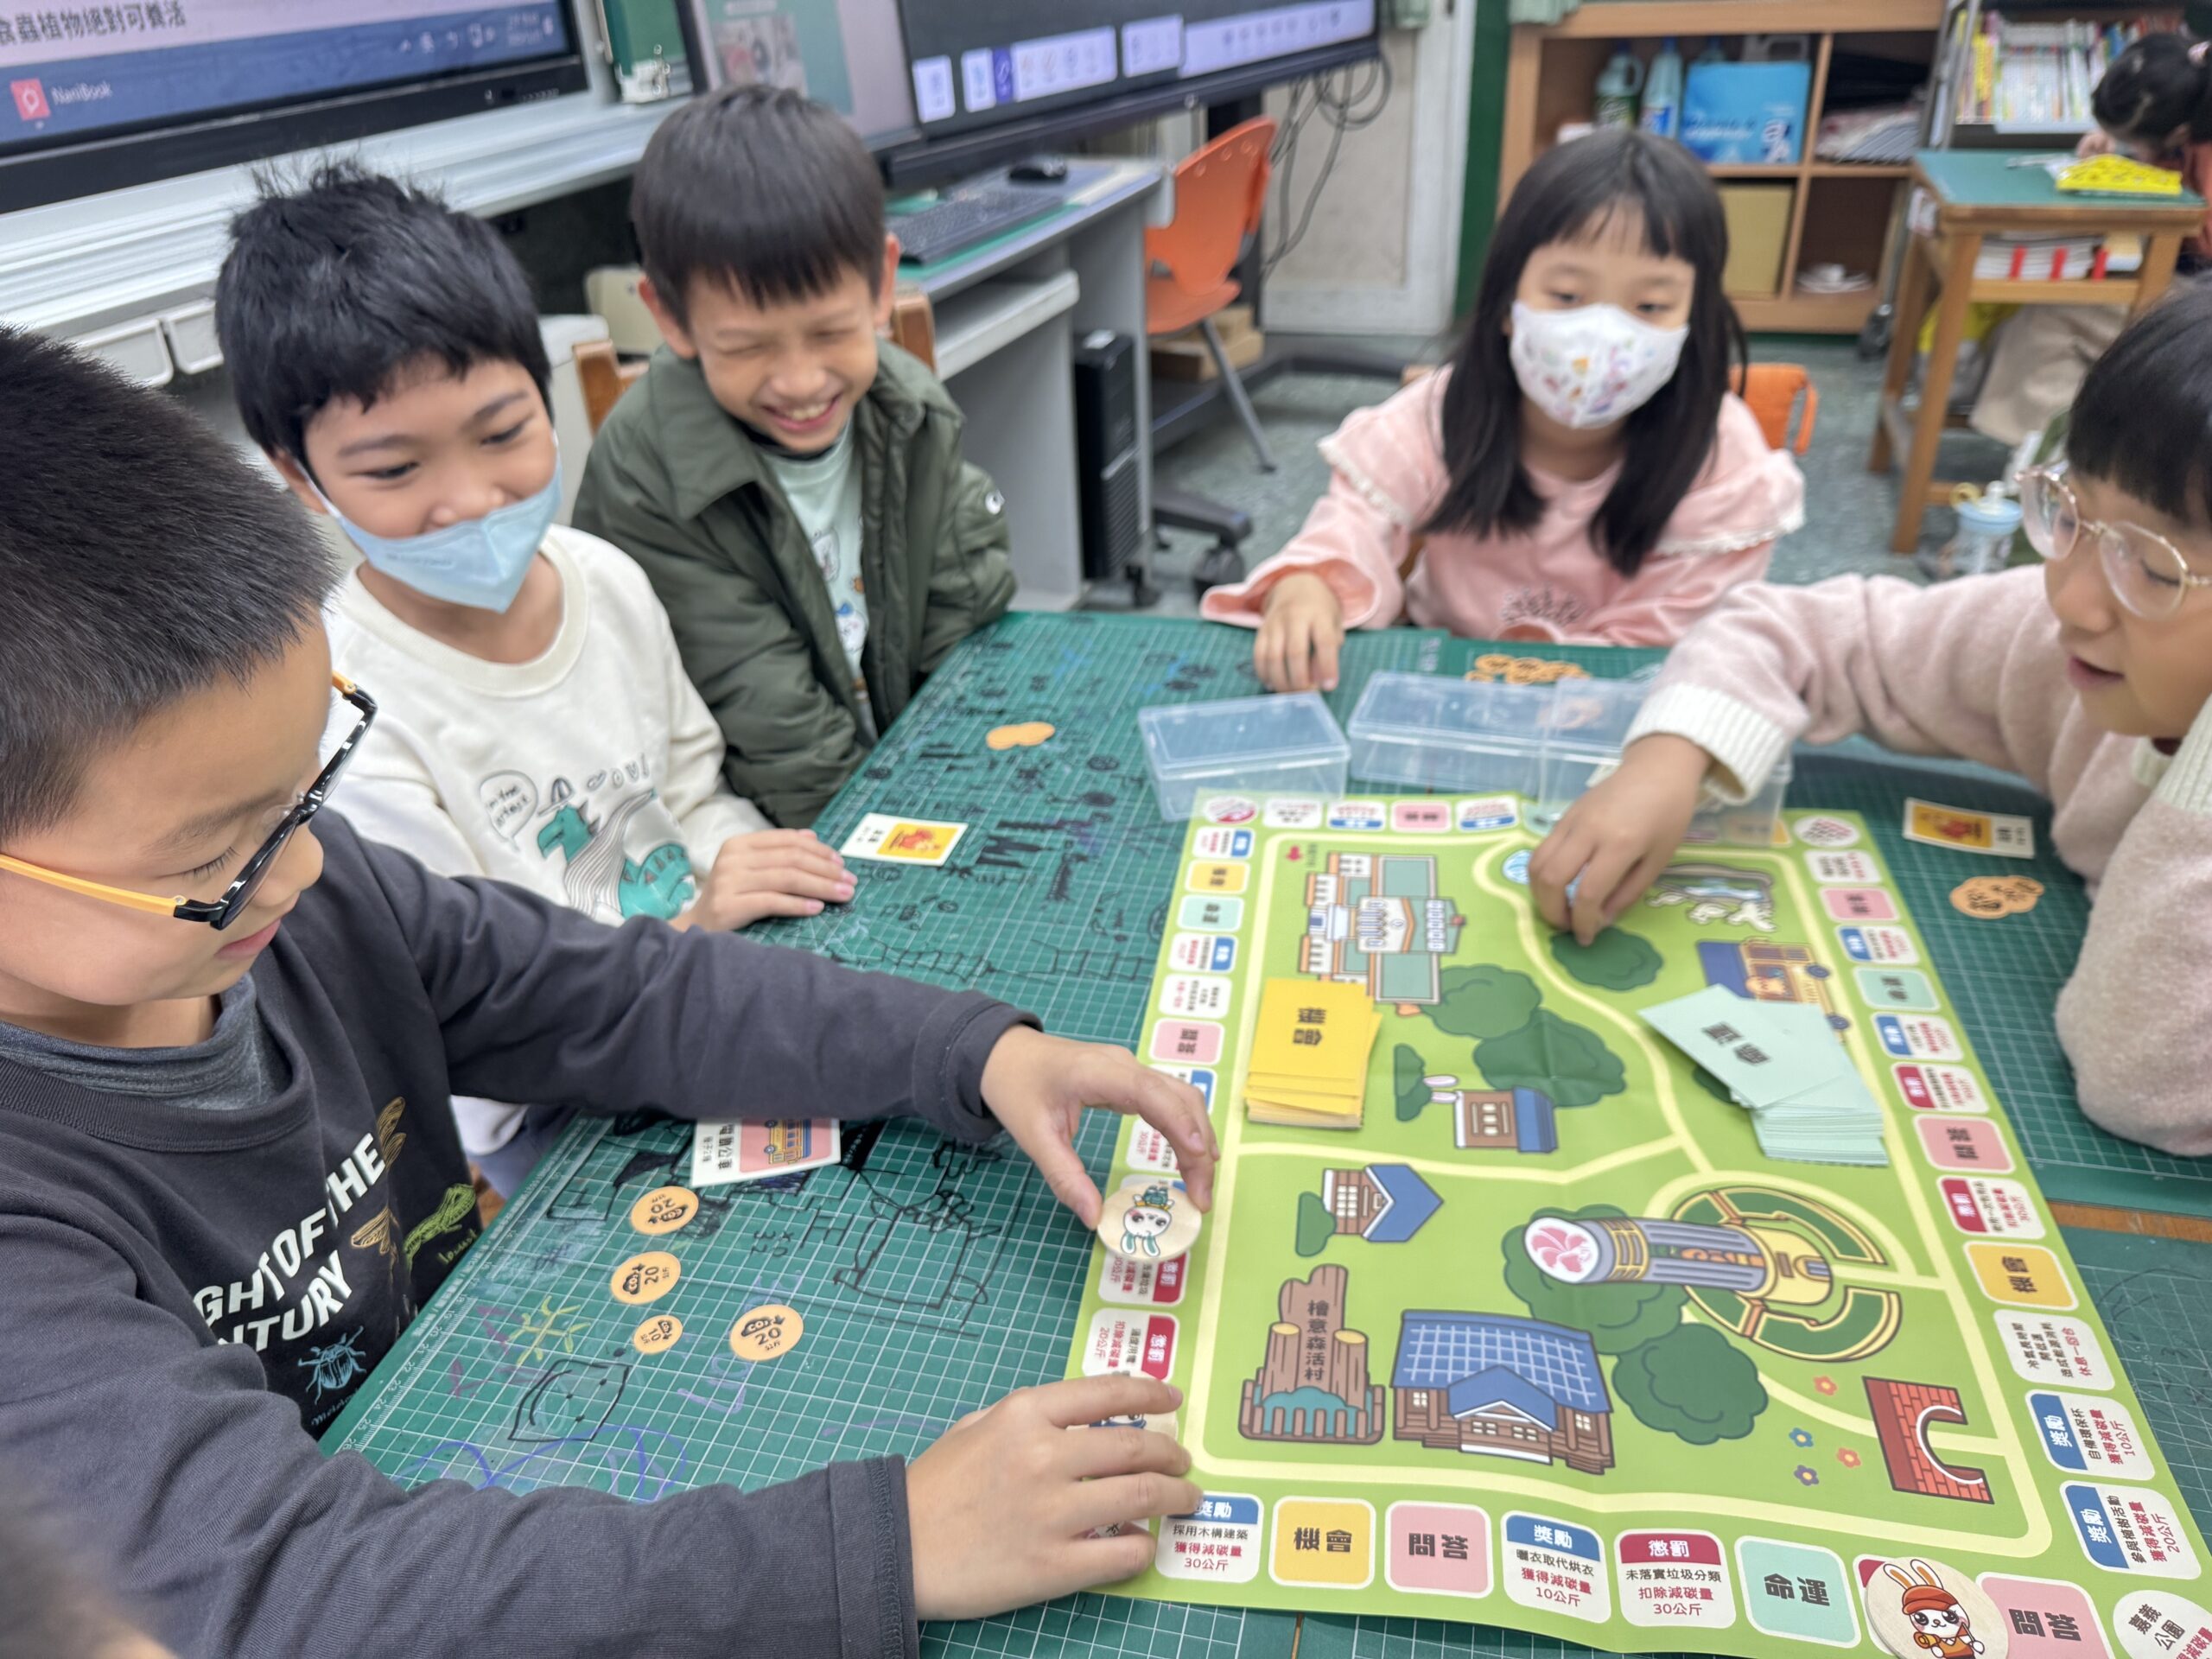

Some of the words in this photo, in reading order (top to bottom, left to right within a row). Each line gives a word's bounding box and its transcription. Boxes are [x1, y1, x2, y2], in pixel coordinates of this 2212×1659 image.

[1293, 1007, 1327, 1046] 機會
[1947, 1127, 1980, 1160] 問答
[651, 1198, 675, 1215] 20
[272, 1208, 327, 1278] OF
[644, 1265, 660, 1286] 20
[2002, 1255, 2038, 1293] 機會
[649, 1328, 661, 1341] 10
[755, 1326, 782, 1344] 20
[1095, 1326, 1109, 1359] 20公斤
[1108, 1319, 1126, 1368] 扣除減碳量
[1147, 1334, 1167, 1363] 懲罰
[1304, 1300, 1330, 1382] 檜意森活村
[2040, 1322, 2074, 1378] 造成能源消耗
[2062, 1327, 2093, 1376] 休息一回合
[403, 1360, 415, 1374] 22
[388, 1378, 401, 1393] 23
[374, 1397, 386, 1411] 24
[358, 1417, 371, 1432] 25
[2044, 1414, 2073, 1447] 獎勵
[2070, 1408, 2101, 1459] 自備環保杯
[2089, 1409, 2124, 1465] 獲得減碳量
[2110, 1421, 2135, 1456] 10公斤
[1173, 1524, 1249, 1540] 採用木構建築
[1294, 1526, 1353, 1554] 機會
[1534, 1524, 1573, 1549] 獎勵
[2081, 1508, 2113, 1544] 獎勵
[2105, 1495, 2147, 1564] 參與植樹活動
[2128, 1501, 2168, 1562] 獲得減碳量
[2152, 1513, 2180, 1554] 20公斤
[1174, 1541, 1242, 1557] 獲得減碳量
[1408, 1533, 1469, 1561] 問答
[1648, 1539, 1690, 1558] 懲罰
[1185, 1557, 1229, 1571] 30公斤
[1516, 1548, 1595, 1577] 曬衣取代烘衣
[1625, 1568, 1722, 1583] 未落實垃圾分類
[1522, 1567, 1592, 1595] 獲得減碳量
[1638, 1586, 1714, 1601] 扣除減碳量
[1764, 1572, 1831, 1607] 命運
[1535, 1586, 1581, 1607] 10公斤
[1653, 1602, 1703, 1616] 30公斤
[2007, 1607, 2082, 1643] 問答
[2128, 1603, 2162, 1636] 嘉義
[2154, 1619, 2186, 1651] 公園
